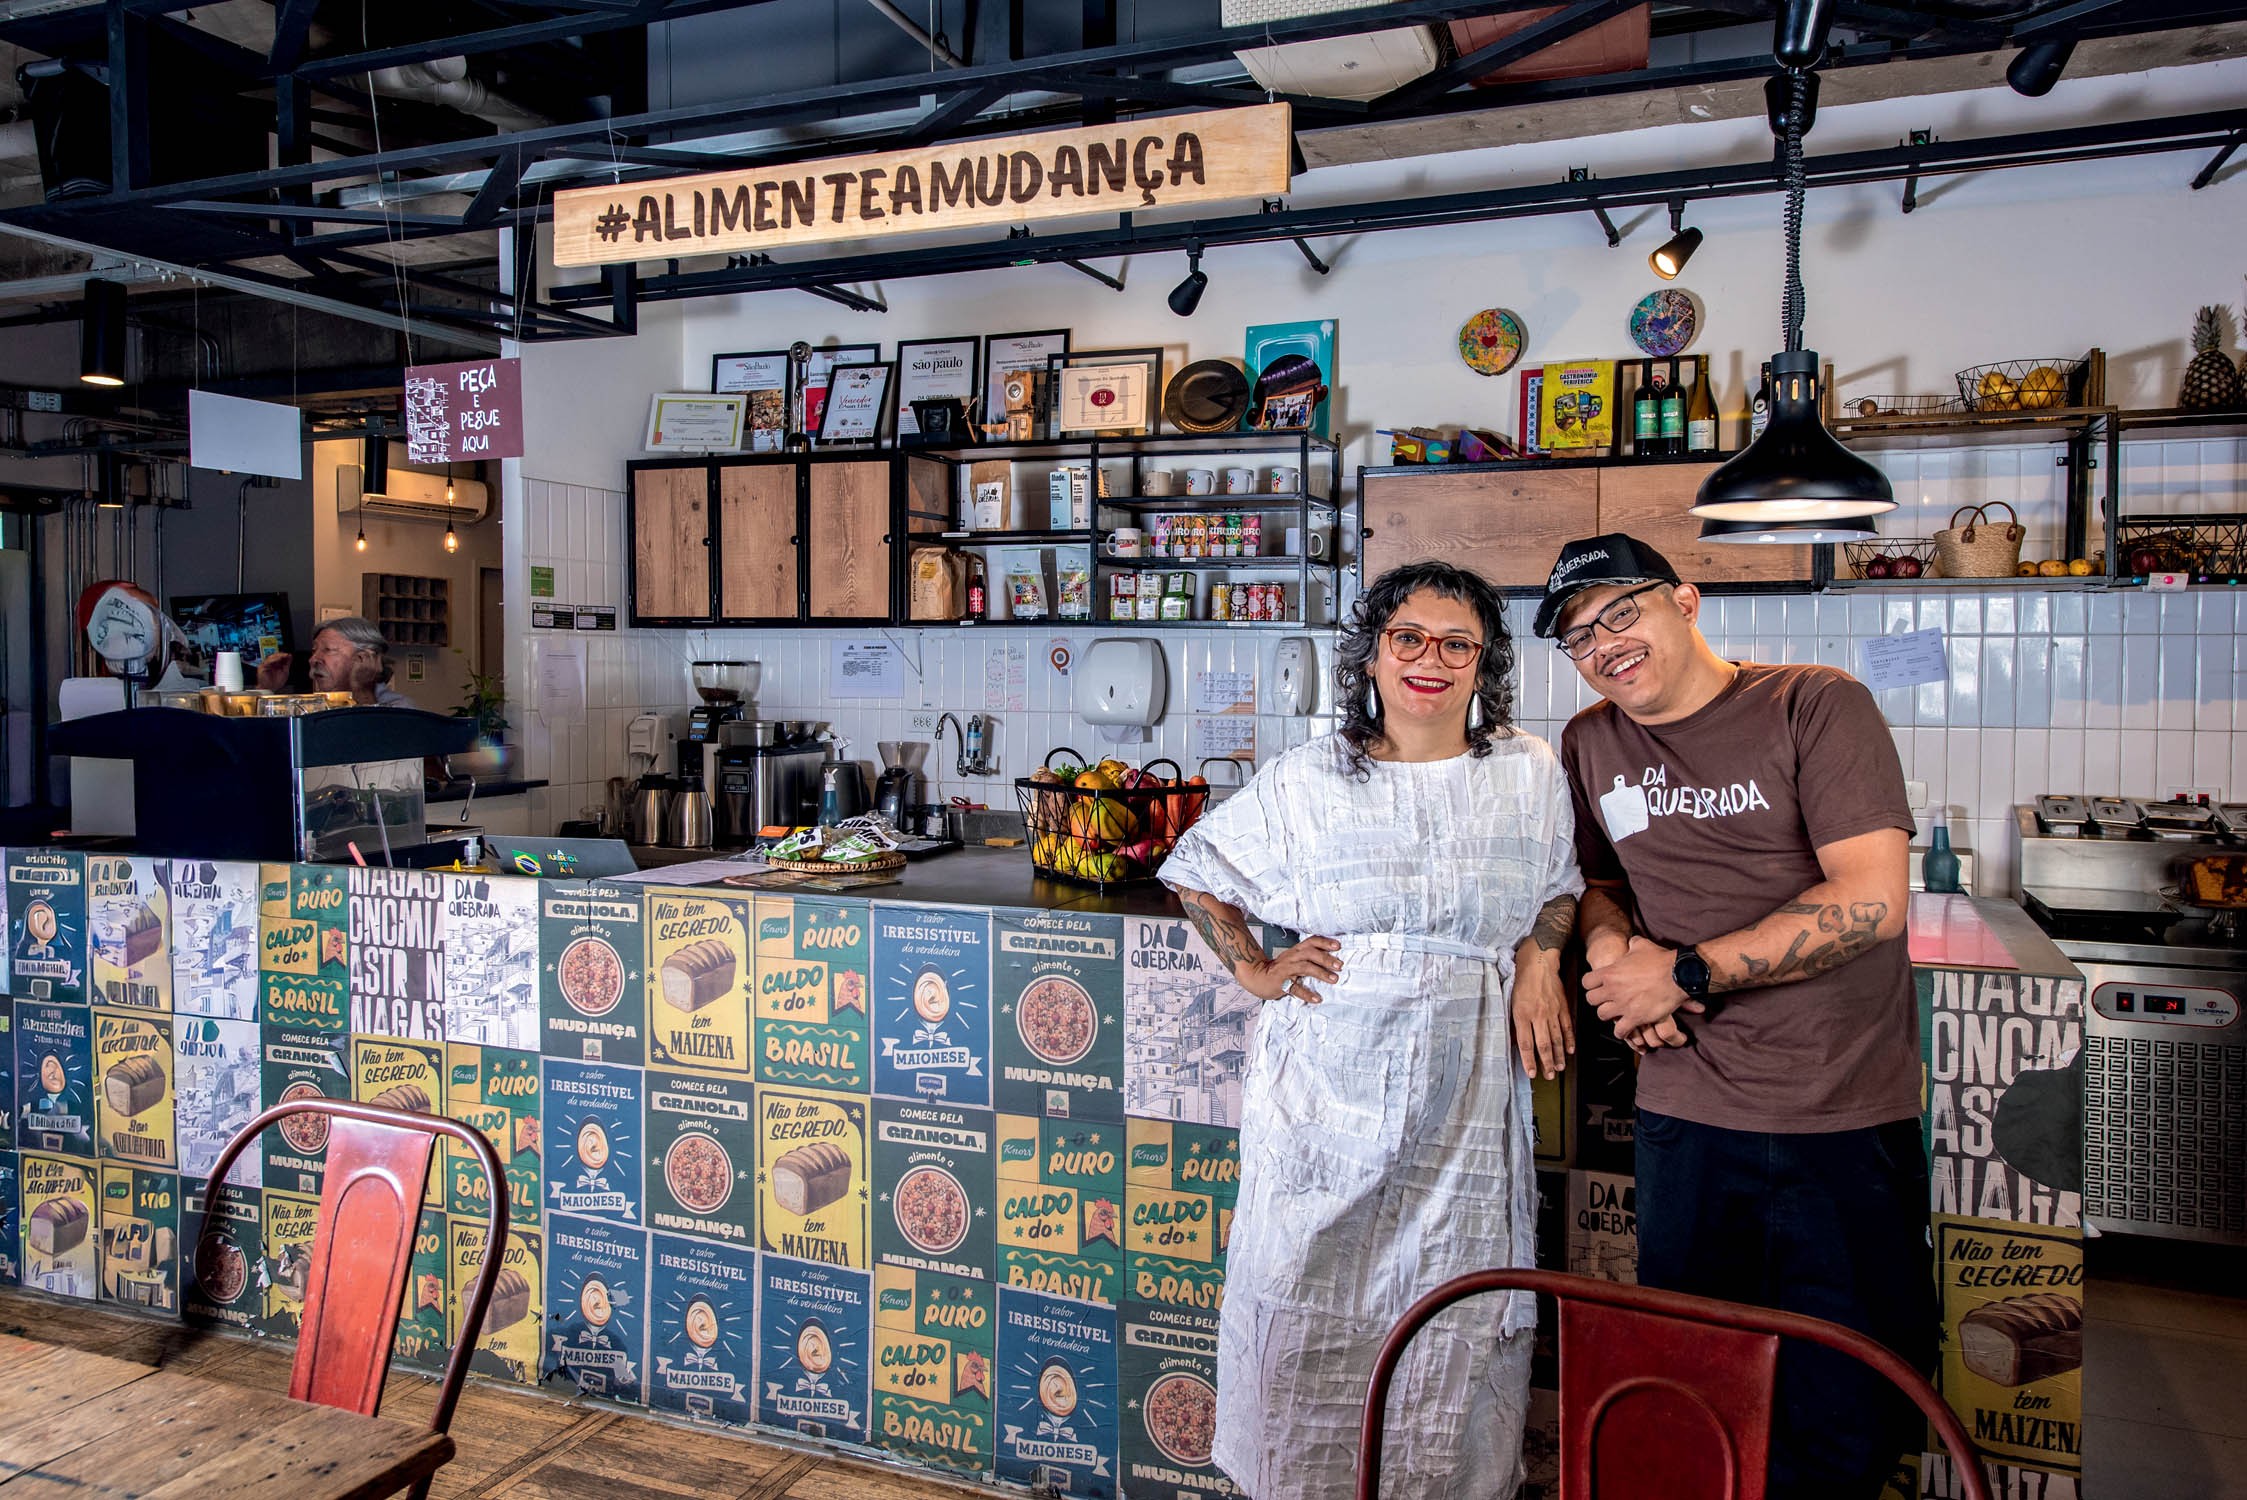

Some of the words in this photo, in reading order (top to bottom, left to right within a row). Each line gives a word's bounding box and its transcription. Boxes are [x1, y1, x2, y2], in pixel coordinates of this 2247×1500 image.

[596, 132, 1205, 243] #ALIMENTEAMUDANÇA
[912, 359, 931, 371] são
[932, 356, 963, 373] paulo
[460, 364, 496, 392] PEÇA
[473, 394, 480, 408] E
[461, 409, 500, 430] PEGUE
[462, 436, 489, 452] AQUI
[1559, 549, 1610, 578] QUEBRADA
[1642, 763, 1666, 788] DA
[1647, 779, 1770, 819] QUEBRADA
[296, 887, 343, 912] PURO
[455, 879, 473, 900] DA
[448, 901, 501, 919] QUEBRADA
[655, 903, 681, 922] Não
[683, 901, 706, 917] tem
[658, 916, 734, 942] SEGREDO,
[882, 925, 981, 945] IRRESISTÍVEL
[1023, 917, 1062, 931] COMECE
[1065, 920, 1092, 932] PELA
[266, 924, 315, 950] CALDO
[801, 924, 861, 951] PURO
[1008, 935, 1112, 957] GRANOLA,
[1140, 923, 1164, 950] DA
[282, 947, 300, 964] do
[901, 943, 914, 954] da
[915, 944, 961, 957] verdadeira
[1032, 959, 1071, 975] alimente
[1073, 967, 1082, 977] a
[1130, 950, 1204, 973] QUEBRADA
[762, 965, 824, 995] CALDO
[267, 986, 340, 1017] BRASIL
[783, 991, 806, 1011] do
[548, 1017, 637, 1040] MUDANÇA
[690, 1014, 712, 1029] tem
[281, 1033, 309, 1045] COMECE
[310, 1035, 329, 1047] PELA
[669, 1030, 735, 1060] MAIZENA
[271, 1048, 330, 1065] GRANOL
[360, 1049, 381, 1065] Não
[384, 1047, 406, 1063] tem
[765, 1037, 856, 1070] BRASIL
[896, 1050, 966, 1066] MAIONESE
[363, 1062, 429, 1085] SEGREDO,
[1004, 1066, 1113, 1094] MUDANÇA
[487, 1074, 539, 1097] PURO
[551, 1079, 635, 1100] IRRESISTÍVEL
[670, 1079, 705, 1092] COMECE
[706, 1083, 728, 1096] PELA
[567, 1095, 578, 1106] da
[579, 1099, 618, 1111] verdadeira
[658, 1095, 745, 1119] GRANOLA,
[766, 1102, 791, 1120] Não
[795, 1101, 820, 1117] tem
[458, 1110, 507, 1132] ALDO
[677, 1119, 712, 1131] alimente
[712, 1127, 720, 1135] a
[900, 1107, 938, 1121] COMECE
[939, 1112, 964, 1125] PELA
[769, 1119, 848, 1141] SEGREDO,
[886, 1125, 983, 1150] GRANOLA,
[908, 1151, 946, 1165] alimente
[947, 1159, 955, 1168] a
[1003, 1144, 1033, 1158] Knorr
[1134, 1149, 1166, 1163] Knorr
[1049, 1150, 1115, 1176] PURO
[456, 1172, 534, 1207] BRIL
[1589, 1180, 1620, 1210] DA
[271, 1204, 291, 1220] Não
[293, 1204, 313, 1218] tem
[562, 1194, 623, 1208] MAIONESE
[1003, 1193, 1073, 1221] CALDO
[1133, 1199, 1208, 1226] CALDO
[1577, 1208, 1637, 1236] QUEBR
[654, 1212, 746, 1240] MUDANÇA
[803, 1218, 825, 1233] tem
[1028, 1215, 1052, 1239] do
[1159, 1225, 1185, 1245] do
[456, 1231, 478, 1248] Não
[555, 1232, 640, 1261] IRRESISTÍVEL
[781, 1234, 850, 1267] MAIZENA
[1949, 1237, 1993, 1262] Não
[2000, 1239, 2043, 1260] tem
[459, 1247, 527, 1267] SEGDO,
[571, 1251, 582, 1262] da
[583, 1254, 623, 1270] verdadeira
[659, 1253, 747, 1281] IRRESISTÍVEL
[675, 1272, 687, 1283] da
[688, 1275, 729, 1291] verdadeira
[769, 1275, 862, 1305] IRRESISTÍVEL
[1135, 1271, 1223, 1311] BRASI
[787, 1295, 798, 1306] da
[799, 1300, 843, 1315] verdadeira
[922, 1302, 986, 1328] PURO
[1007, 1310, 1112, 1344] IRRESISTÍVEL
[1149, 1310, 1192, 1326] COMECE
[488, 1337, 508, 1350] tem
[1027, 1331, 1040, 1344] da
[1041, 1334, 1090, 1354] verdadeira
[1134, 1328, 1219, 1351] GRANOL
[880, 1342, 946, 1367] CALDO
[1159, 1357, 1202, 1371] alimente
[1204, 1367, 1212, 1376] a
[668, 1372, 732, 1390] MAIONESE
[903, 1368, 926, 1388] do
[779, 1398, 846, 1416] MAIONESE
[2012, 1390, 2052, 1411] tem
[883, 1410, 979, 1454] BRASIL
[1018, 1441, 1093, 1463] MAIONESE
